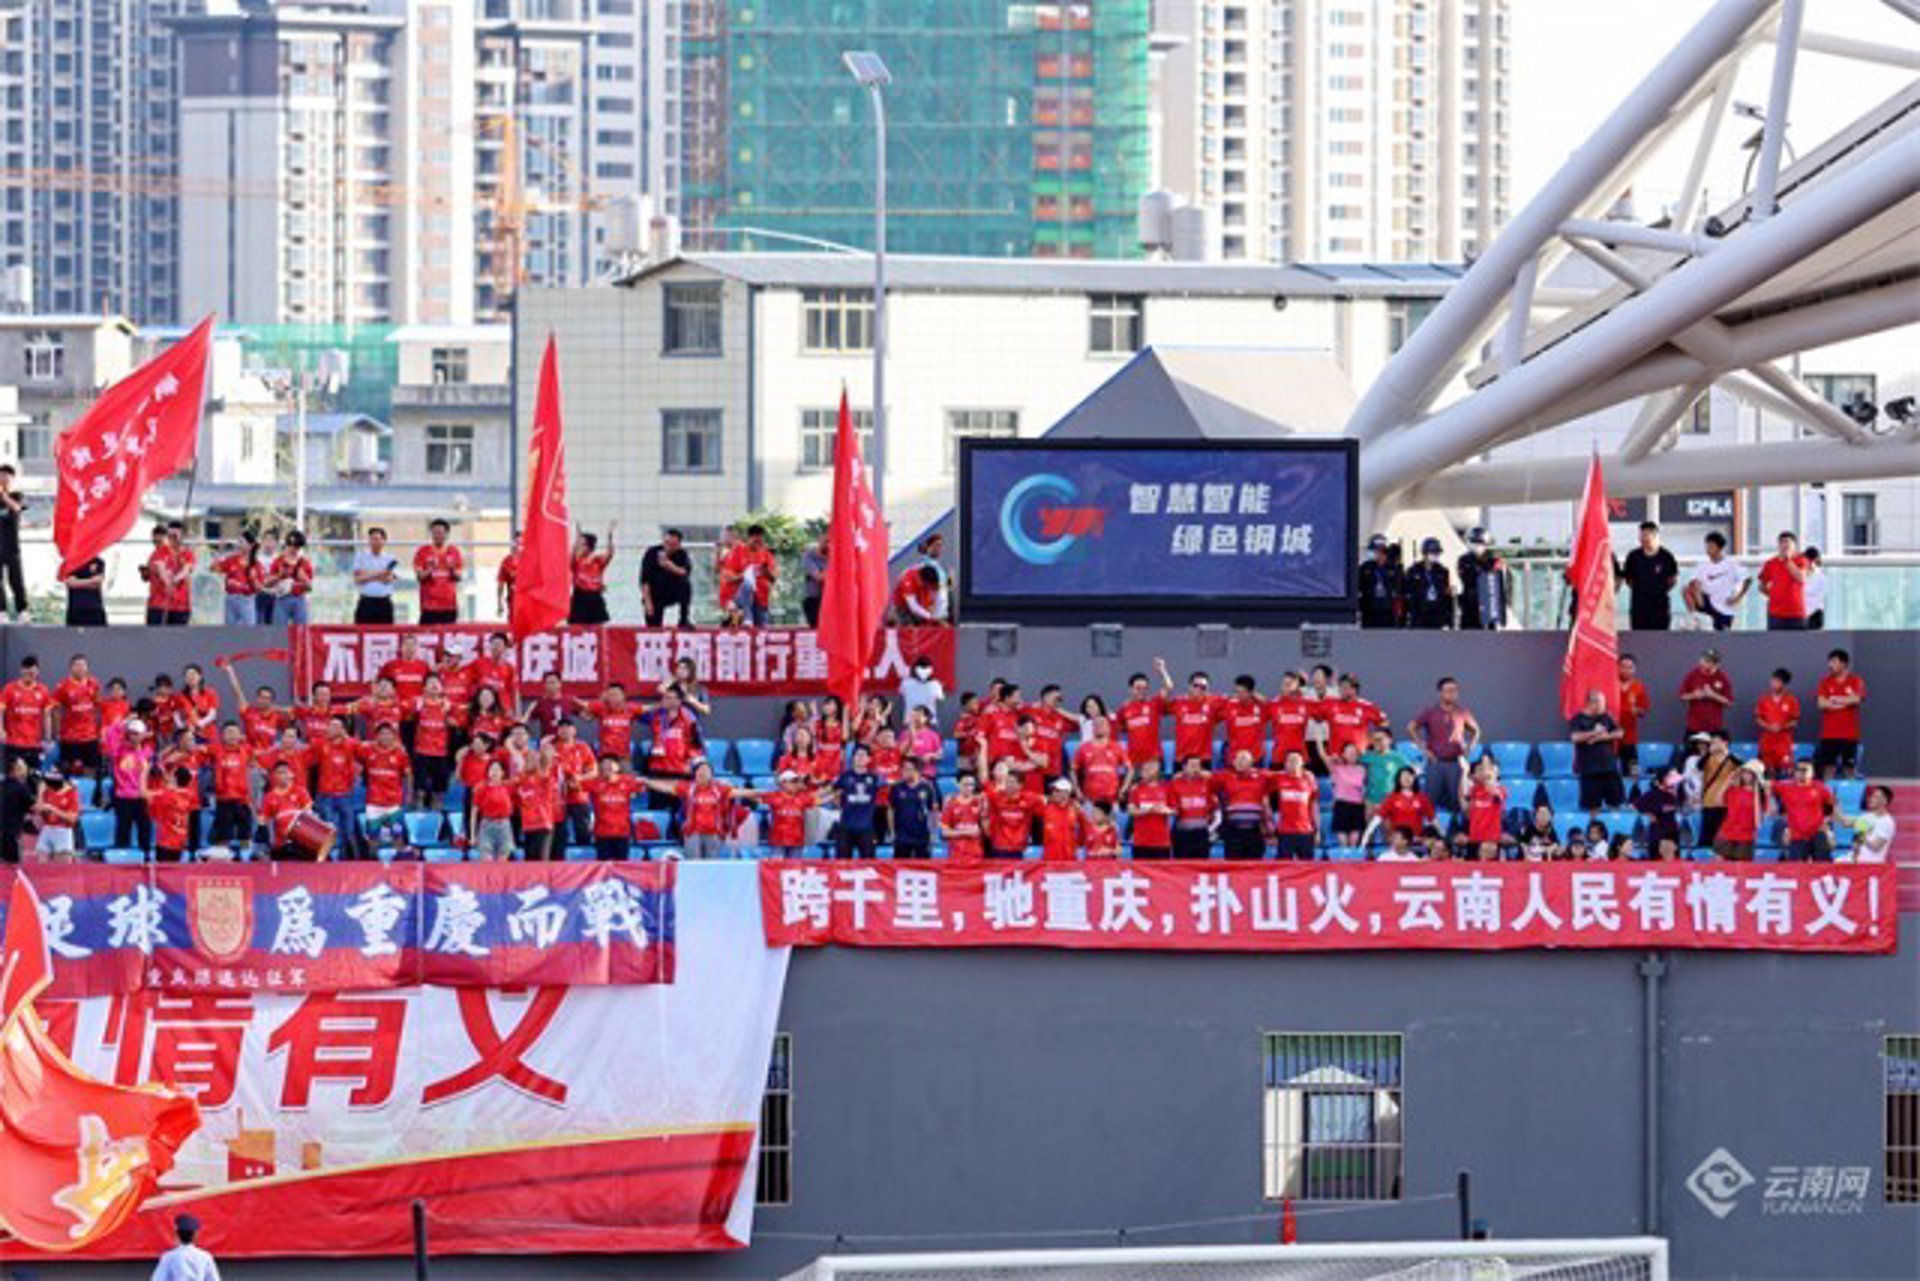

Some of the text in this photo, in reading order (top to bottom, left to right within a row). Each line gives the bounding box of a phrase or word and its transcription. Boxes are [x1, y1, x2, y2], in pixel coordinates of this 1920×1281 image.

[1129, 482, 1272, 514] 智慧智能
[1170, 524, 1314, 556] 绿色钢城
